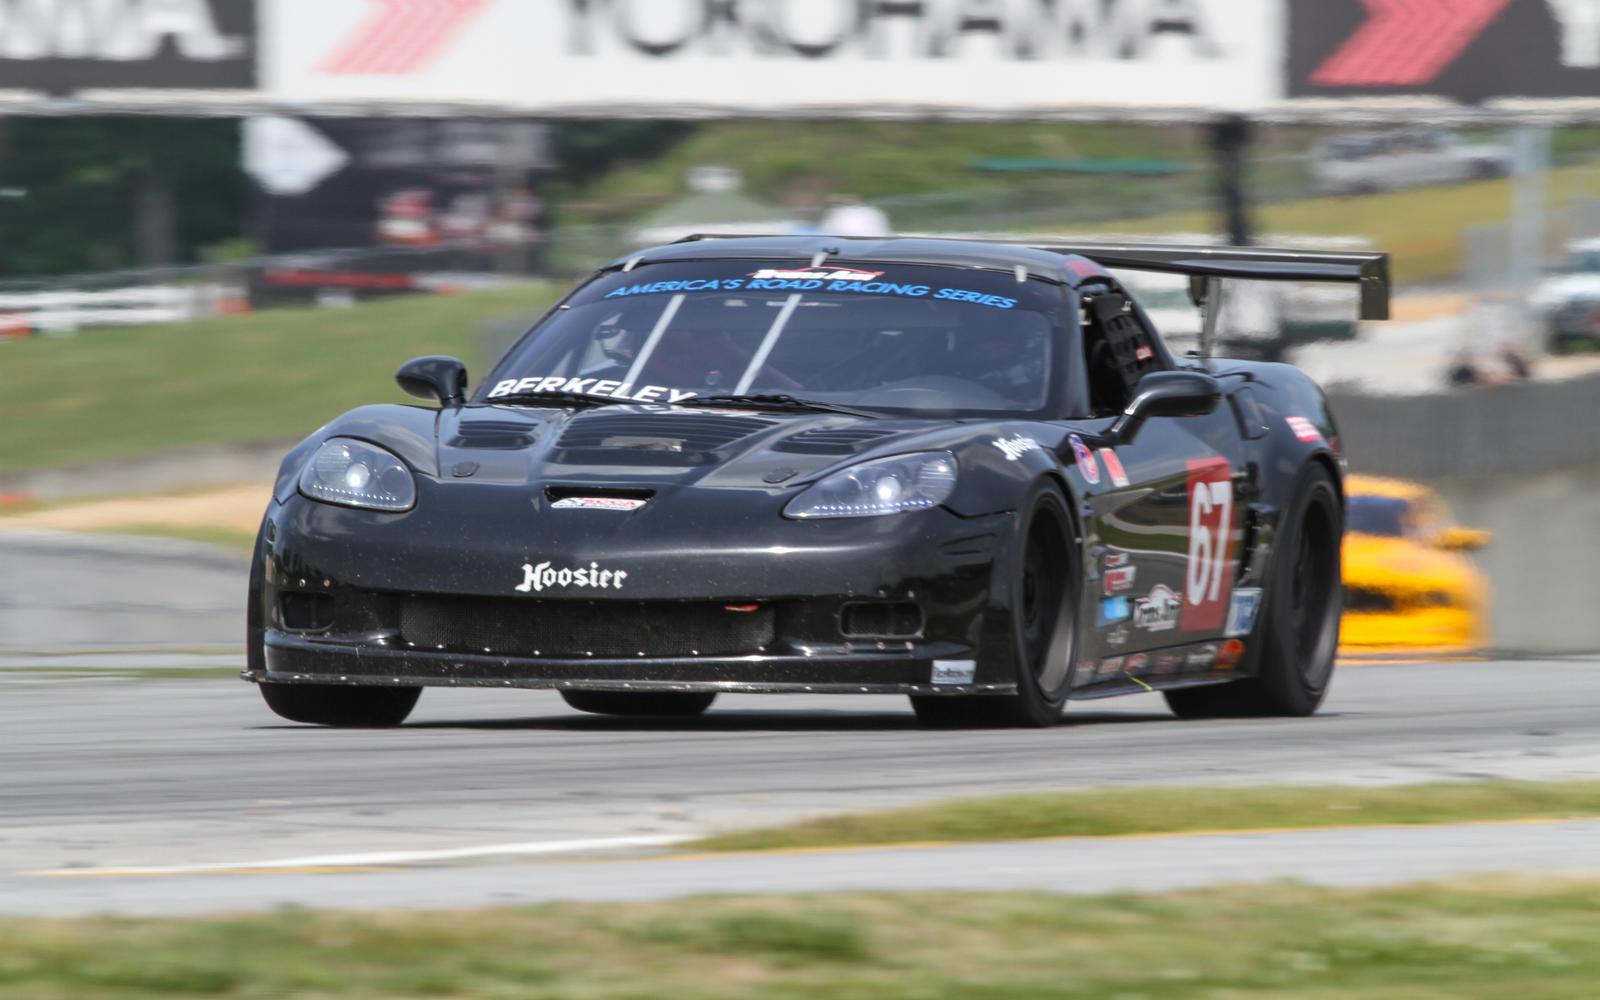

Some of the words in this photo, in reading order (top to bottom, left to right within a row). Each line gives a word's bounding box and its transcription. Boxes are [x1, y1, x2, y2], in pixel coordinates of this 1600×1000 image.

[604, 279, 744, 298] AMERICA'S
[745, 279, 823, 289] ROAD
[826, 280, 932, 296] RACING
[933, 287, 1017, 309] SERIES
[487, 376, 698, 403] BERKELEY
[1187, 481, 1232, 606] 67
[515, 561, 627, 592] Hoosier
